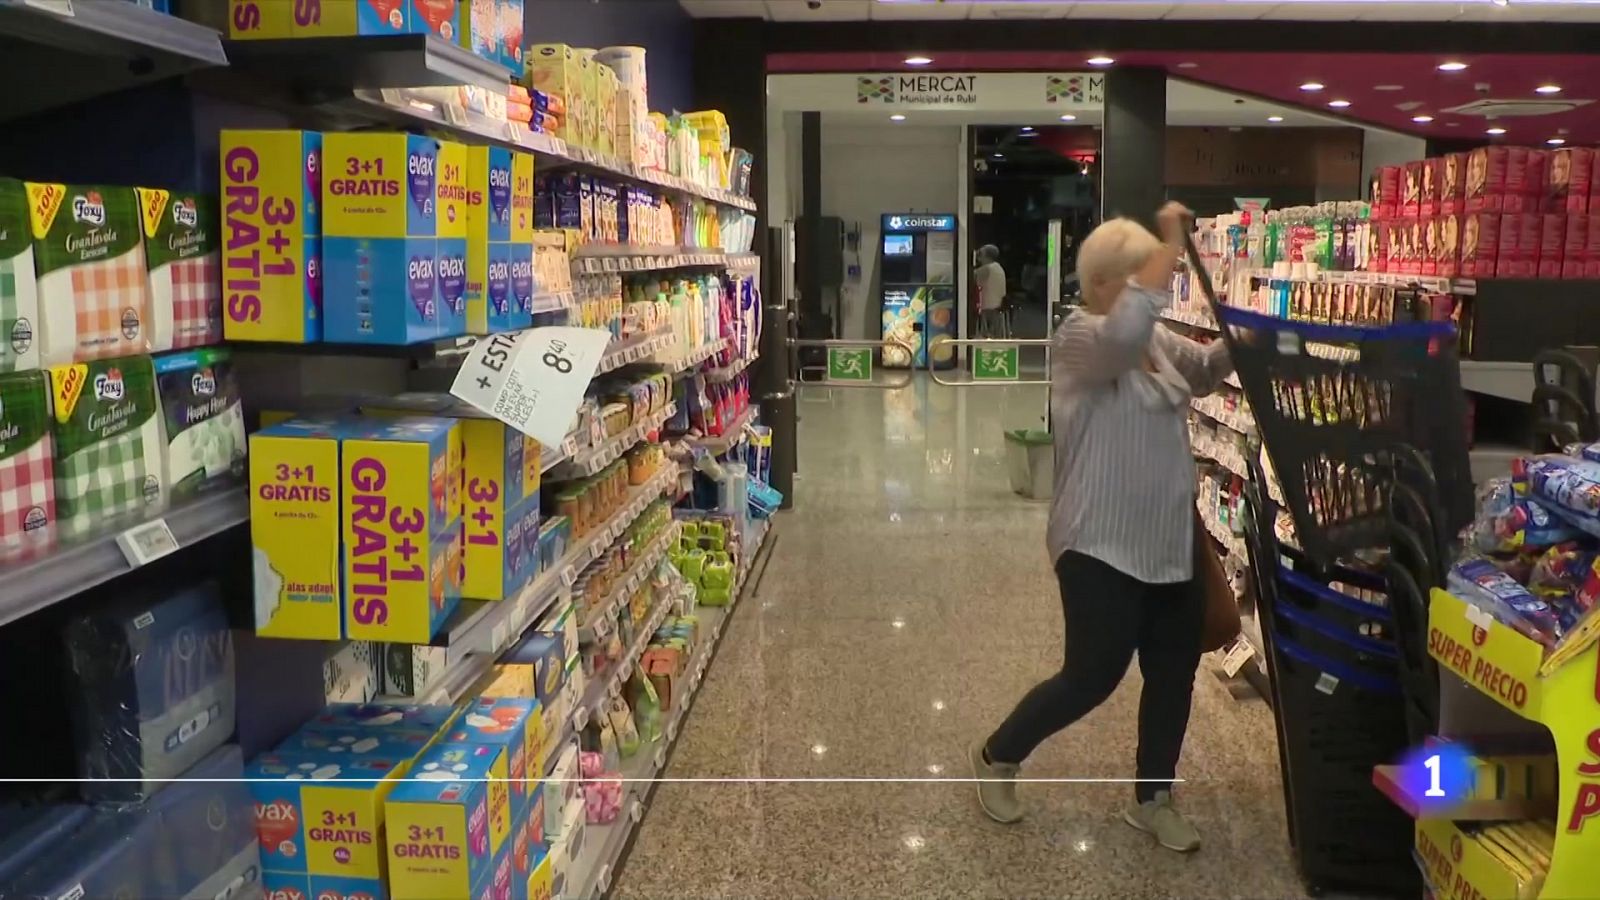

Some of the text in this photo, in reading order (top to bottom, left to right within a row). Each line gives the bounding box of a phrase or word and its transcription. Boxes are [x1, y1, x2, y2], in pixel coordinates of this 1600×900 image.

[900, 75, 977, 92] MERCAT
[900, 94, 941, 104] Municipal
[943, 94, 954, 103] de
[346, 156, 383, 176] 3+1
[409, 154, 433, 176] evax
[444, 163, 459, 181] 3+1
[490, 169, 510, 187] evax
[329, 179, 400, 196] GRATIS
[438, 184, 466, 201] GRATIS
[74, 200, 103, 222] Foxy
[174, 204, 196, 224] Foxy
[904, 216, 948, 228] coinstar
[225, 146, 262, 323] GRATIS
[262, 196, 296, 277] 3+1
[409, 259, 434, 280] evax
[439, 258, 465, 278] evax
[489, 262, 508, 280] evax
[512, 261, 531, 278] evax
[95, 378, 122, 397] Foxy
[193, 376, 214, 393] Foxy
[275, 463, 314, 482] 3+1
[259, 484, 331, 502] GRATIS
[468, 477, 499, 546] 3+1
[351, 456, 388, 626] GRATIS
[389, 506, 425, 582] 3+1
[1429, 627, 1528, 709] SUPER PRECIO
[322, 810, 357, 827] 3+1
[309, 828, 372, 844] GRATIS
[408, 824, 444, 841] 3+1
[394, 843, 460, 860] GRATIS
